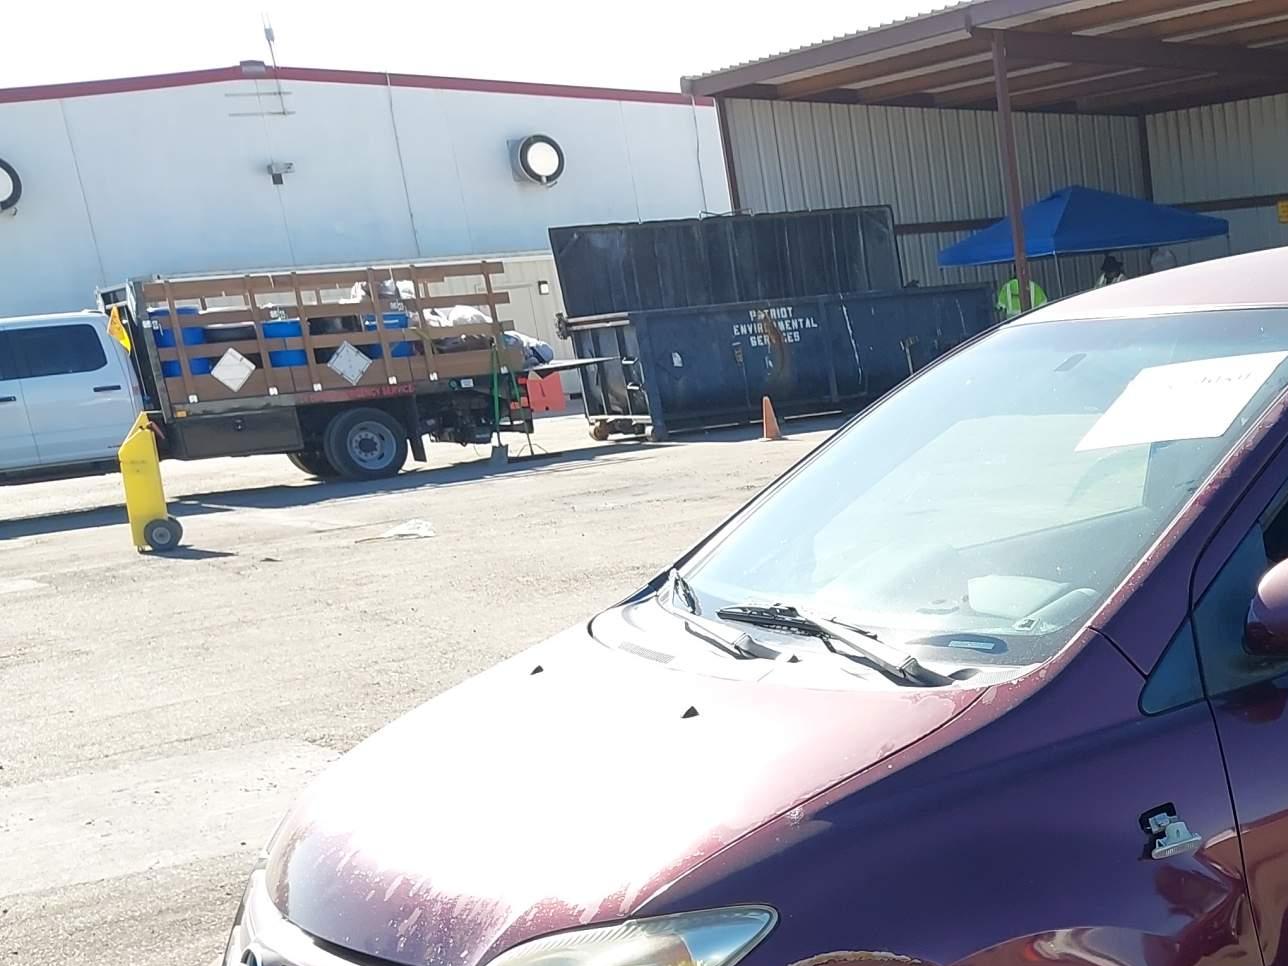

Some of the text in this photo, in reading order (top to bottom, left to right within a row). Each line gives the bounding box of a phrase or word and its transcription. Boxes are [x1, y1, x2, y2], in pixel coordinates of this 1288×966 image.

[749, 307, 793, 321] PATRIOT
[733, 317, 818, 336] ENVIRMENTAL
[749, 331, 801, 347] SERES
